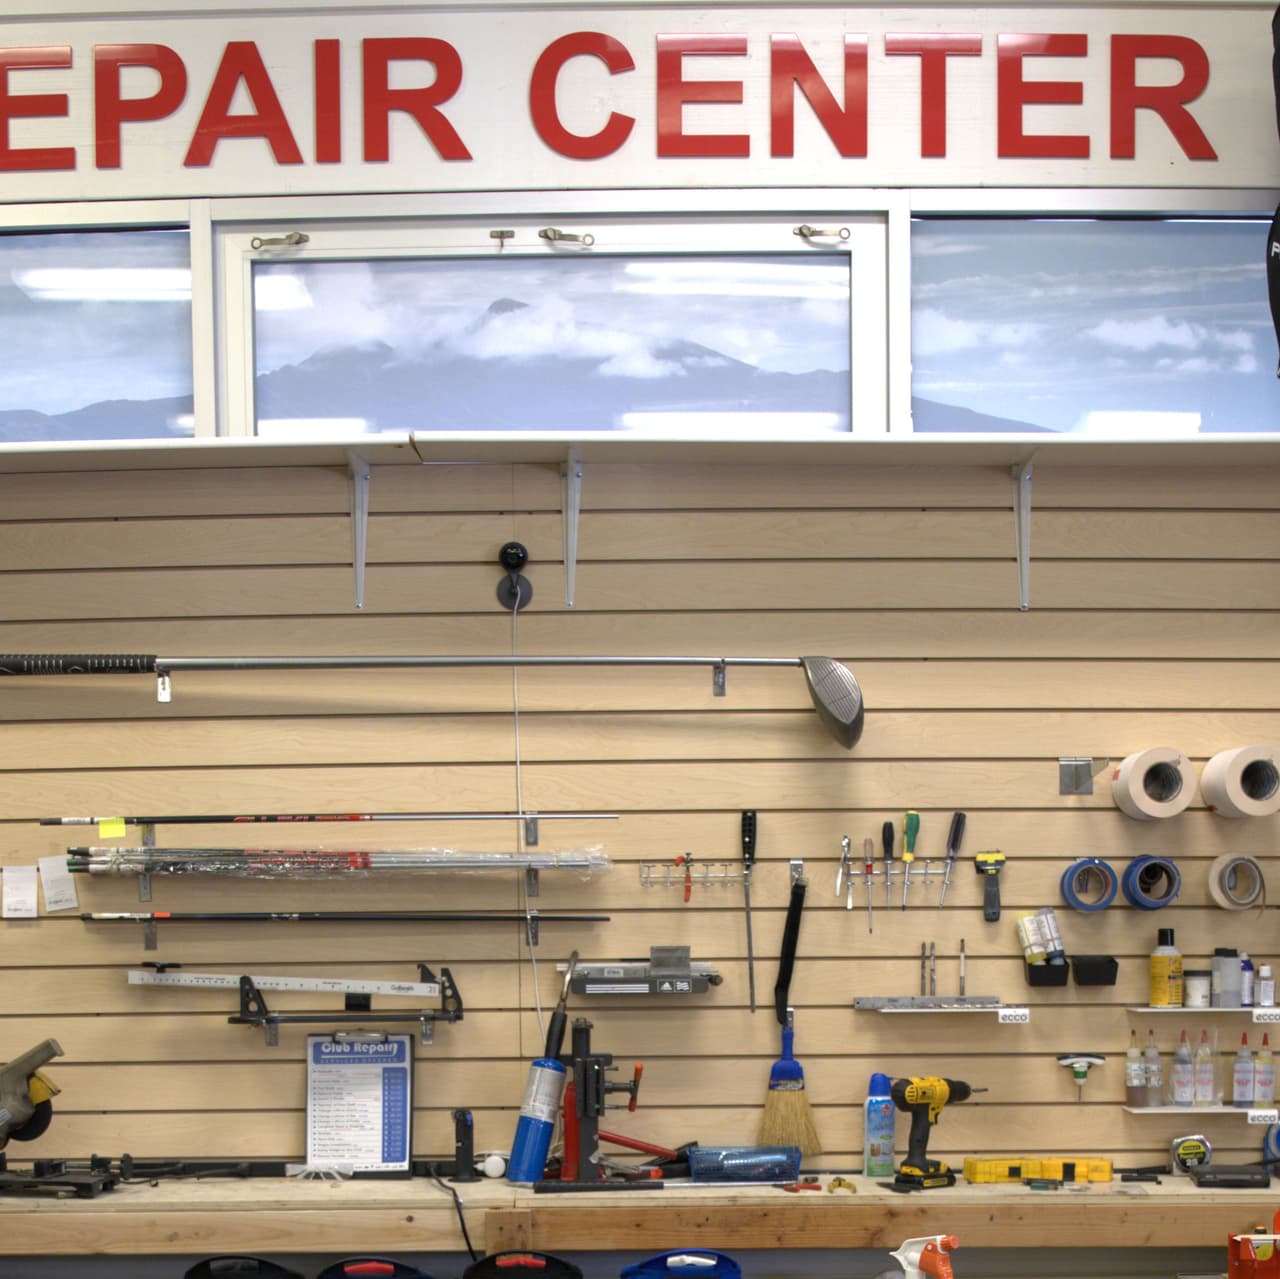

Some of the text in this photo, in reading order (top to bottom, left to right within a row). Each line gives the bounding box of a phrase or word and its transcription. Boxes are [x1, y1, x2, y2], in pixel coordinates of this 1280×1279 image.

[529, 31, 1217, 160] CENTER
[1001, 1014, 1028, 1022] ecco
[1255, 1013, 1280, 1021] ecco
[321, 1043, 350, 1053] Club
